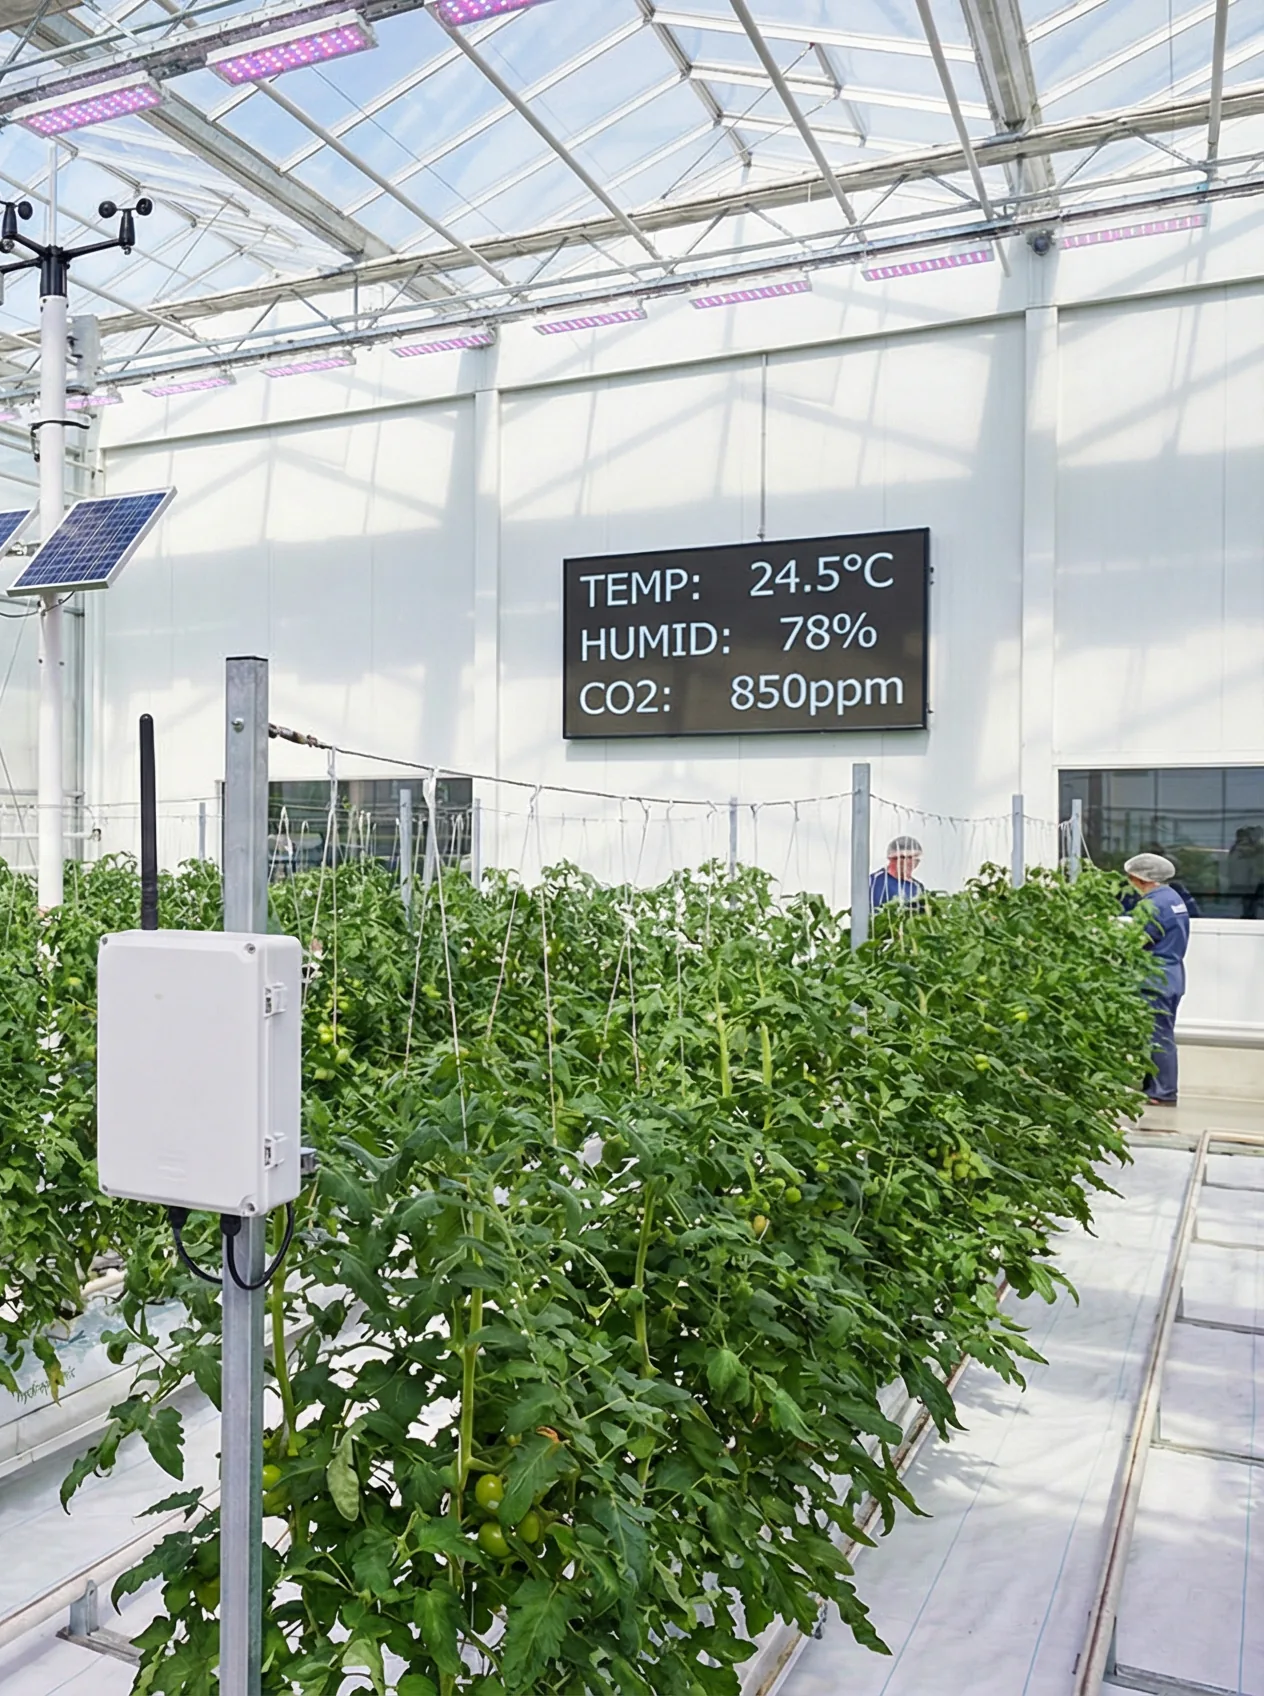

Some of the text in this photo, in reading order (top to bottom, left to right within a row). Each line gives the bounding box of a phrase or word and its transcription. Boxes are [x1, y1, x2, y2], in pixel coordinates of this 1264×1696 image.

[579, 552, 894, 608] TEMP: 24.5°C
[581, 612, 877, 662] HUMID: 78%
[579, 673, 903, 717] CO2: 850ppm
